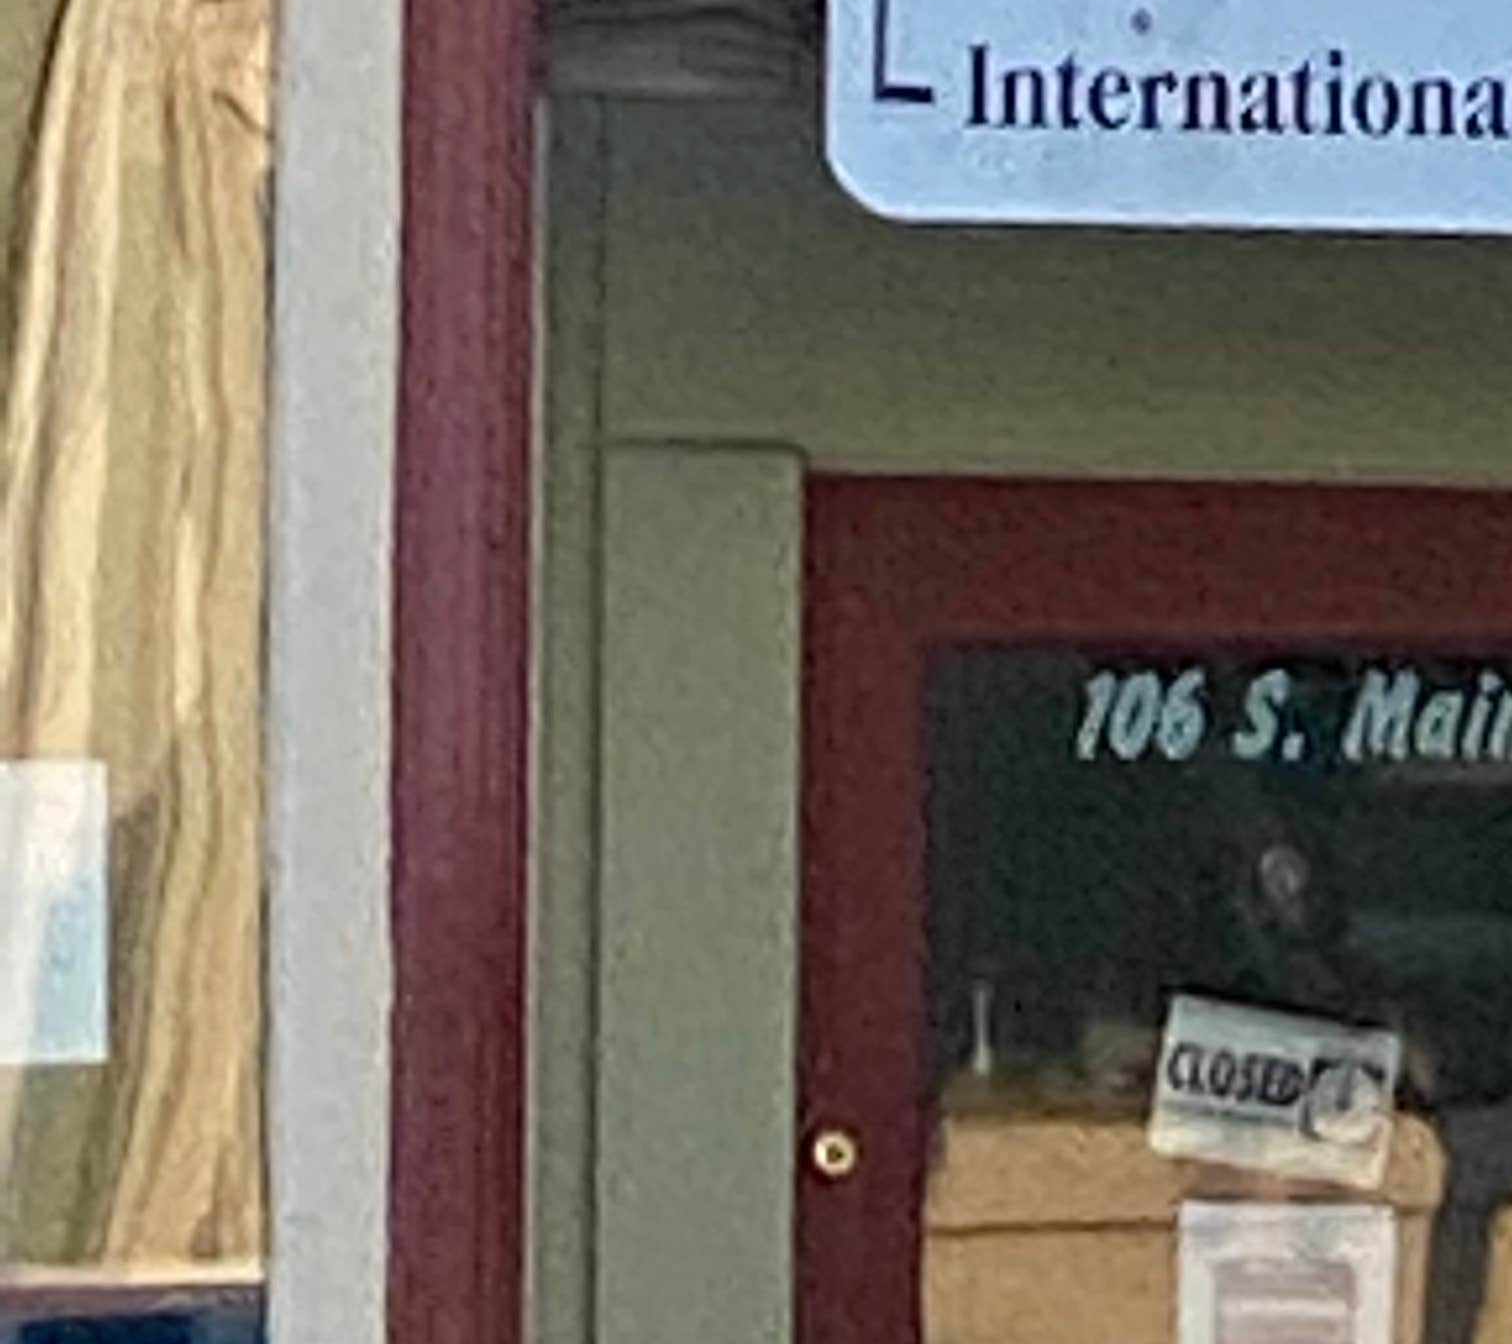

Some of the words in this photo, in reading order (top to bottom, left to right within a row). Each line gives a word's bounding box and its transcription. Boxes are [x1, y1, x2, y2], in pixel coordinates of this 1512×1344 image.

[1075, 667, 1205, 760] 106
[1231, 668, 1304, 760] S.
[1167, 1041, 1306, 1106] CLOSED
